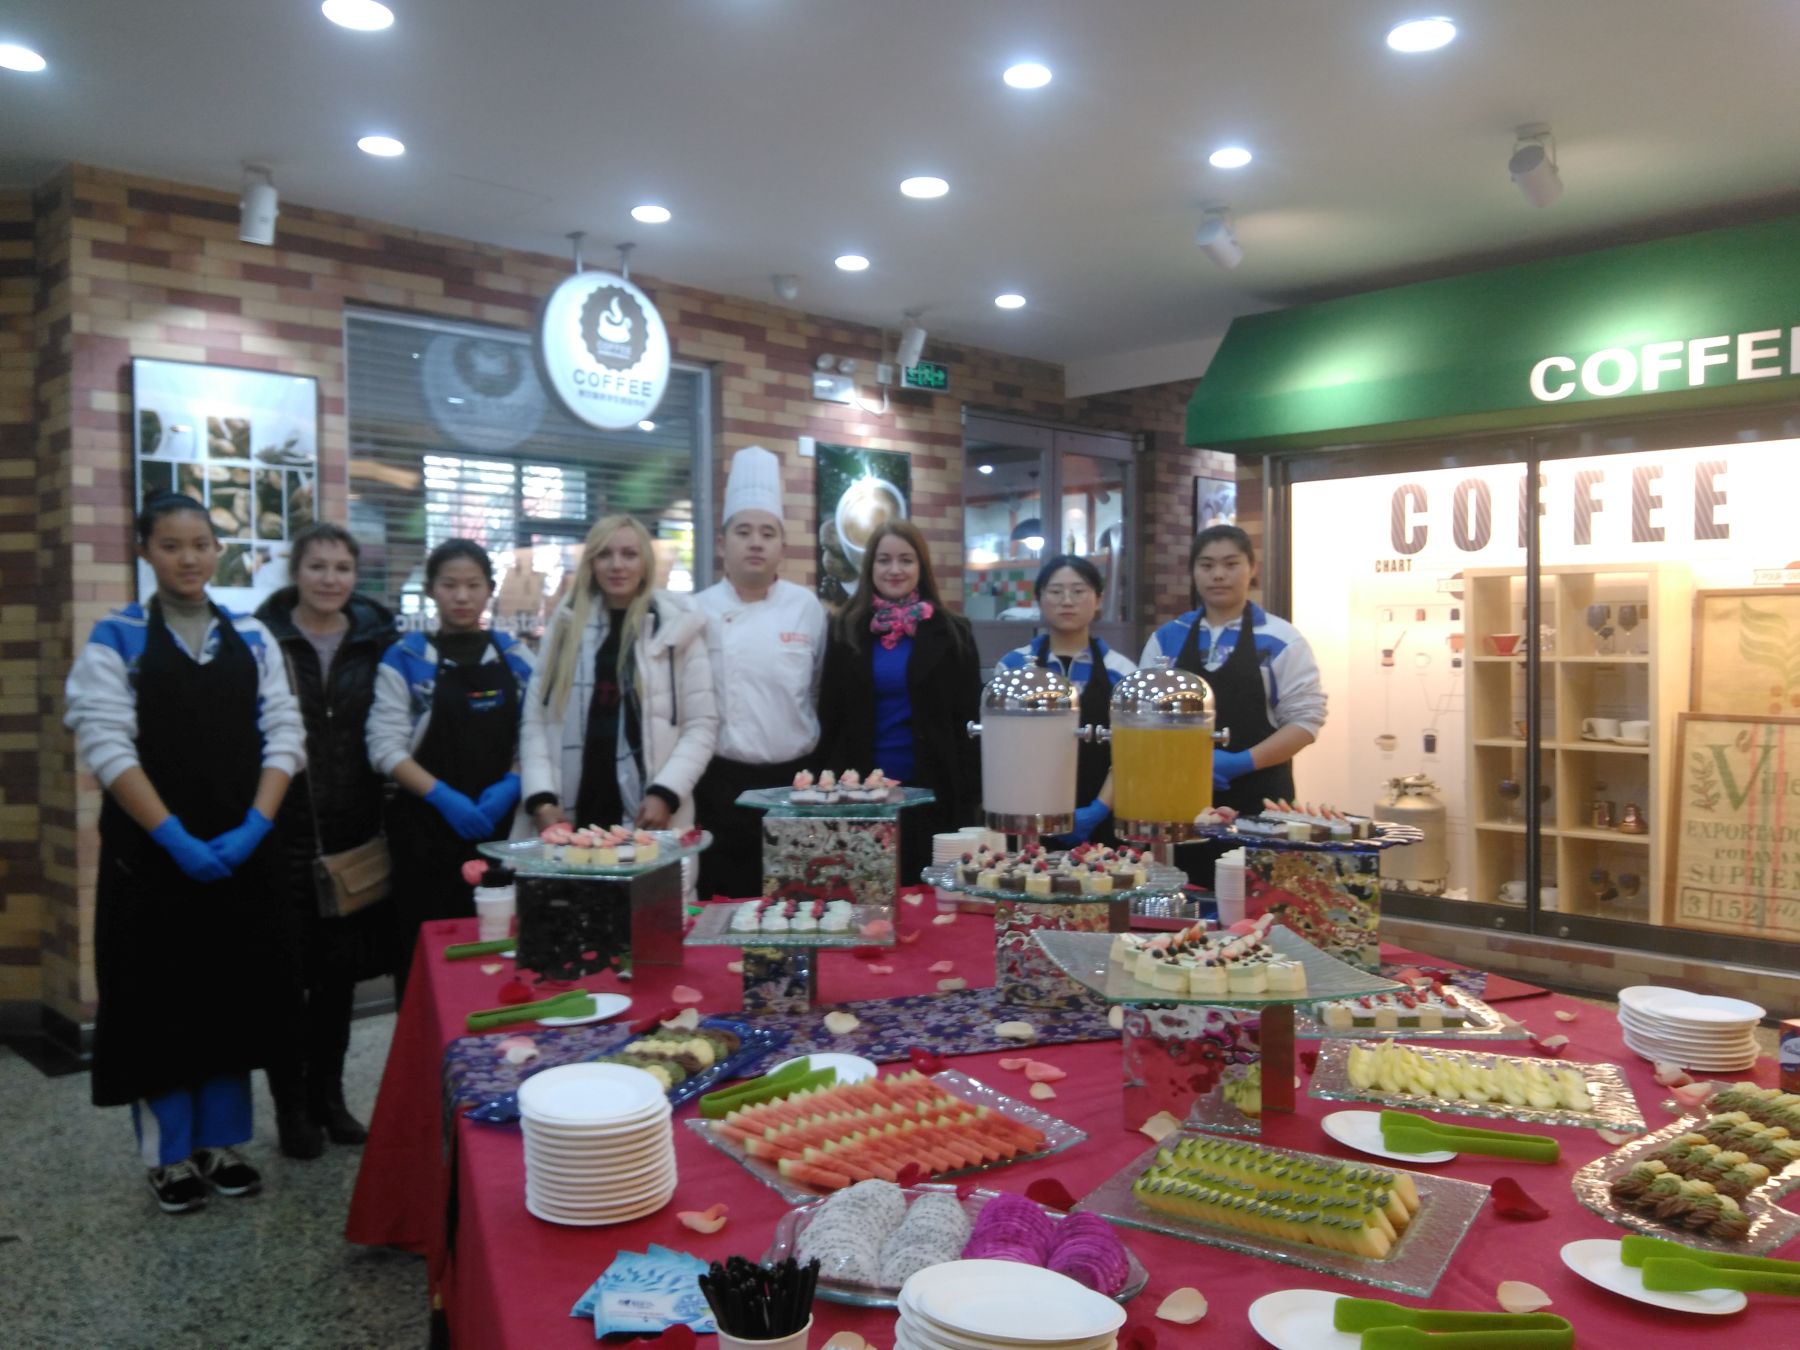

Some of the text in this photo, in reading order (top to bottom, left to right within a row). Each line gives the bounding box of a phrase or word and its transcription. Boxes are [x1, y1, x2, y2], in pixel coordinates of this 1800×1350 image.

[573, 368, 652, 397] COFFEE
[1530, 327, 1800, 402] COFFE
[1391, 460, 1730, 554] COFFEE
[1375, 559, 1412, 573] CHART
